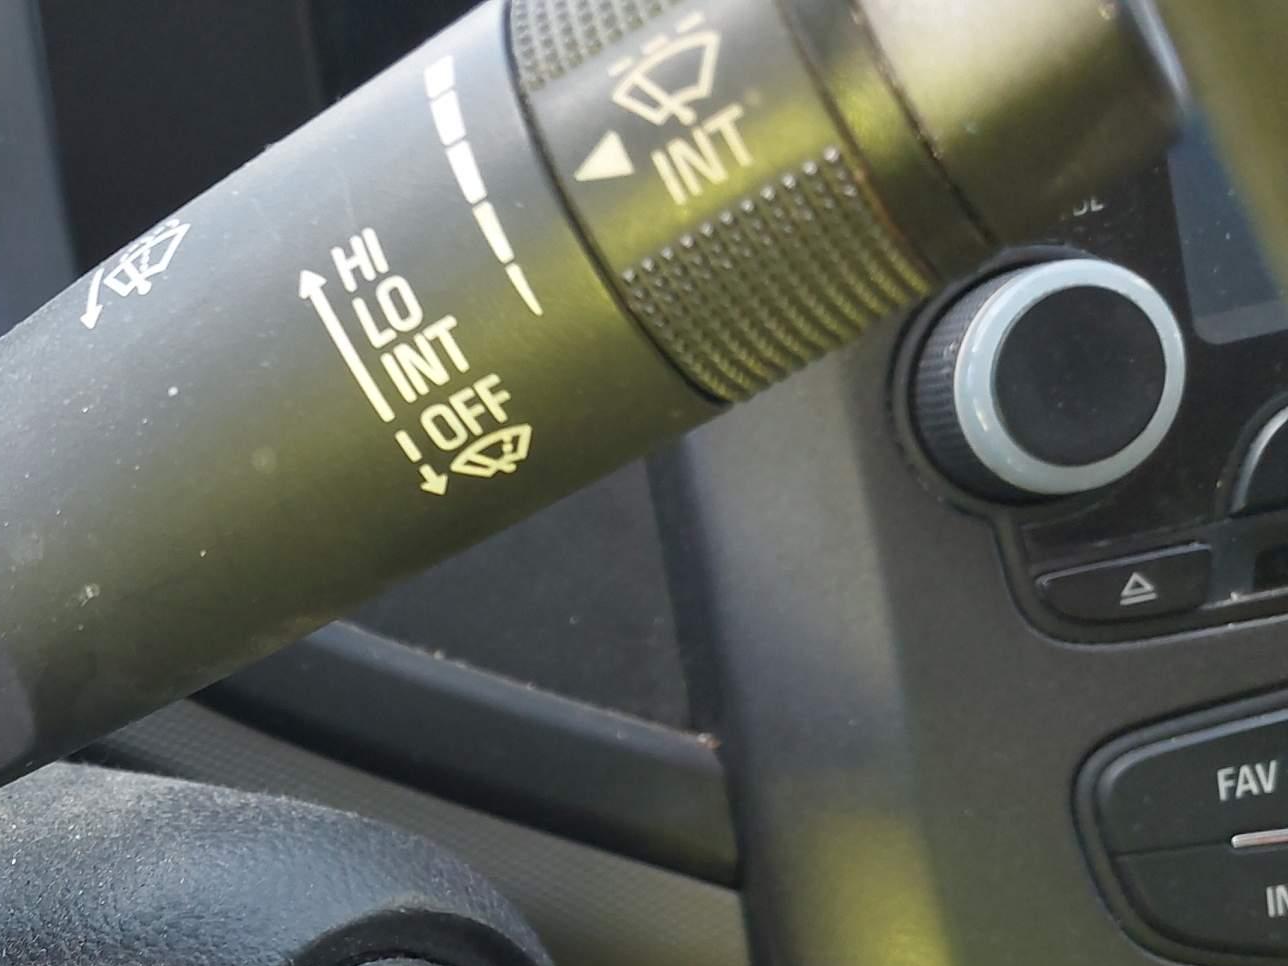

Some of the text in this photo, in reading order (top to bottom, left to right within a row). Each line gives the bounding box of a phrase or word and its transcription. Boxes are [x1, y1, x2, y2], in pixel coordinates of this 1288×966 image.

[650, 105, 754, 206] INT
[331, 228, 389, 292] HI
[352, 274, 423, 348] LO
[380, 314, 470, 404] INT
[420, 373, 512, 452] OFF
[1217, 760, 1278, 801] FAV
